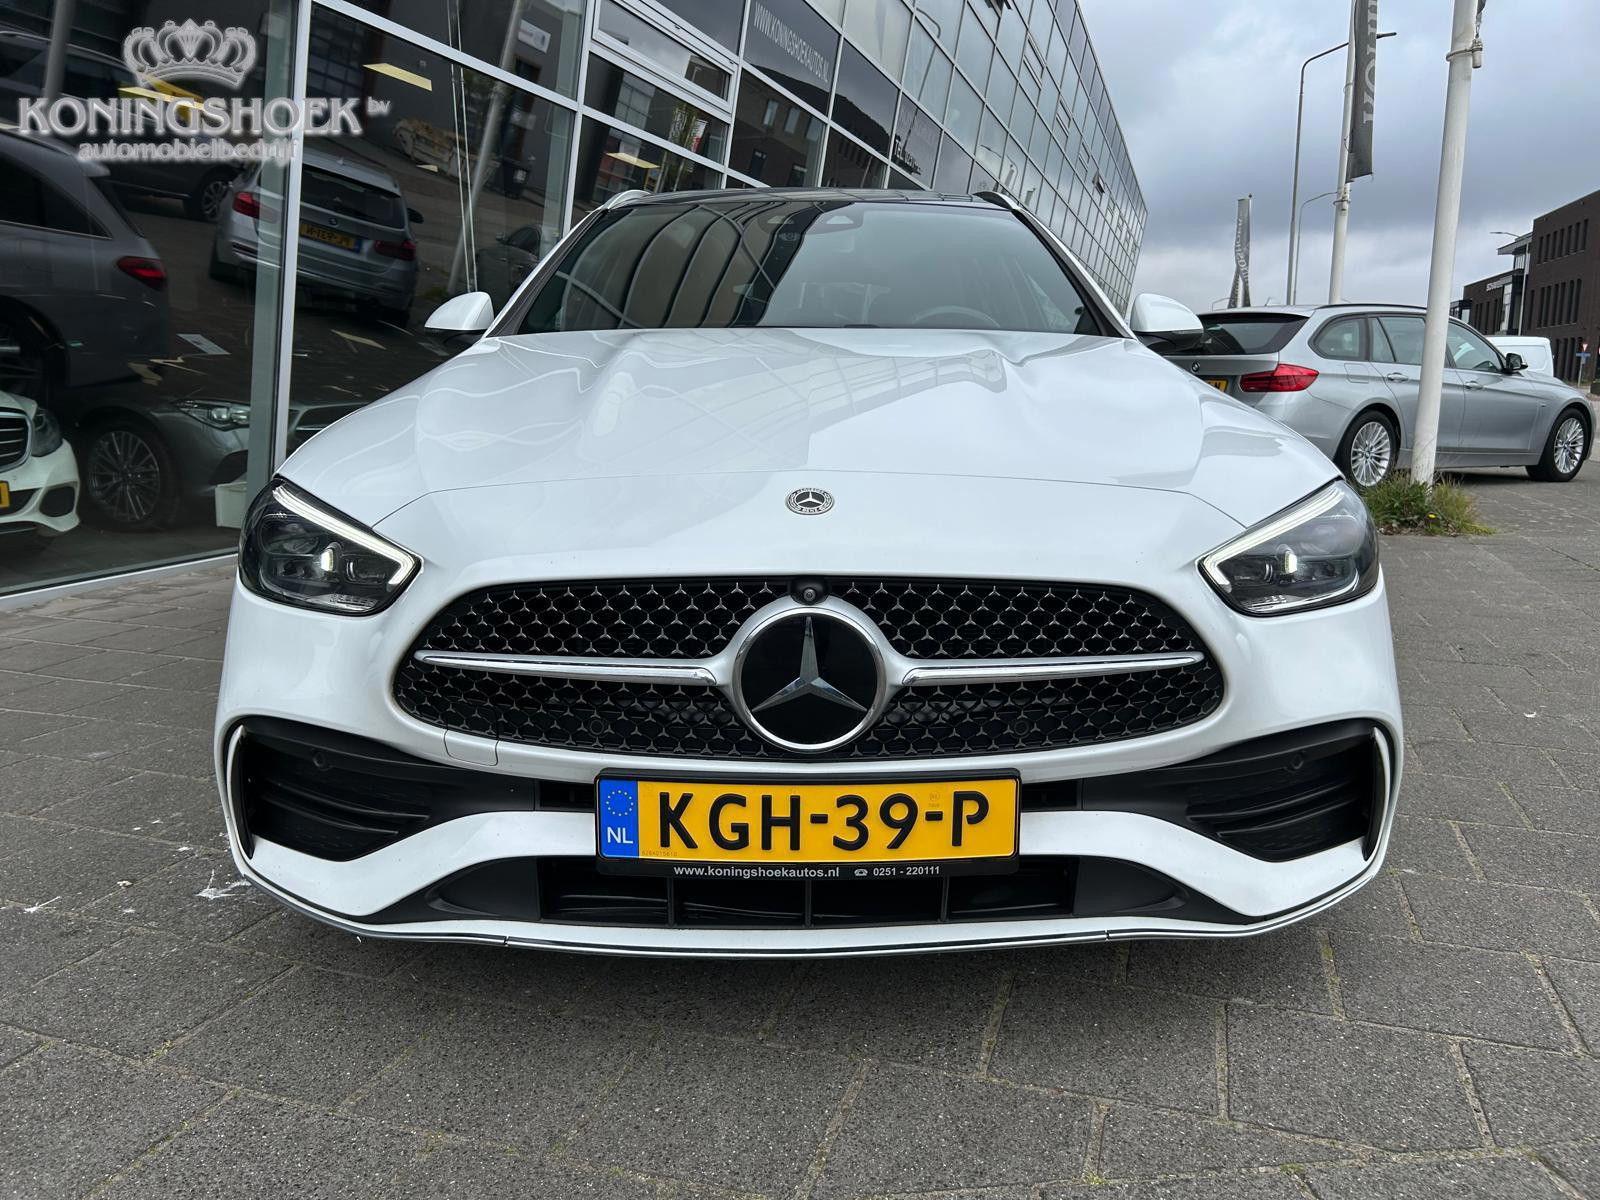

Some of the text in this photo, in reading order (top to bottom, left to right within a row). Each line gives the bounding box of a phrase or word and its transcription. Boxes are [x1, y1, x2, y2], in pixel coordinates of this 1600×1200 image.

[659, 790, 990, 851] KGH-39-P
[607, 827, 633, 844] NL
[673, 865, 840, 879] www.koningshoekautos.nl
[873, 866, 896, 876] 0251
[906, 865, 940, 875] 220111
